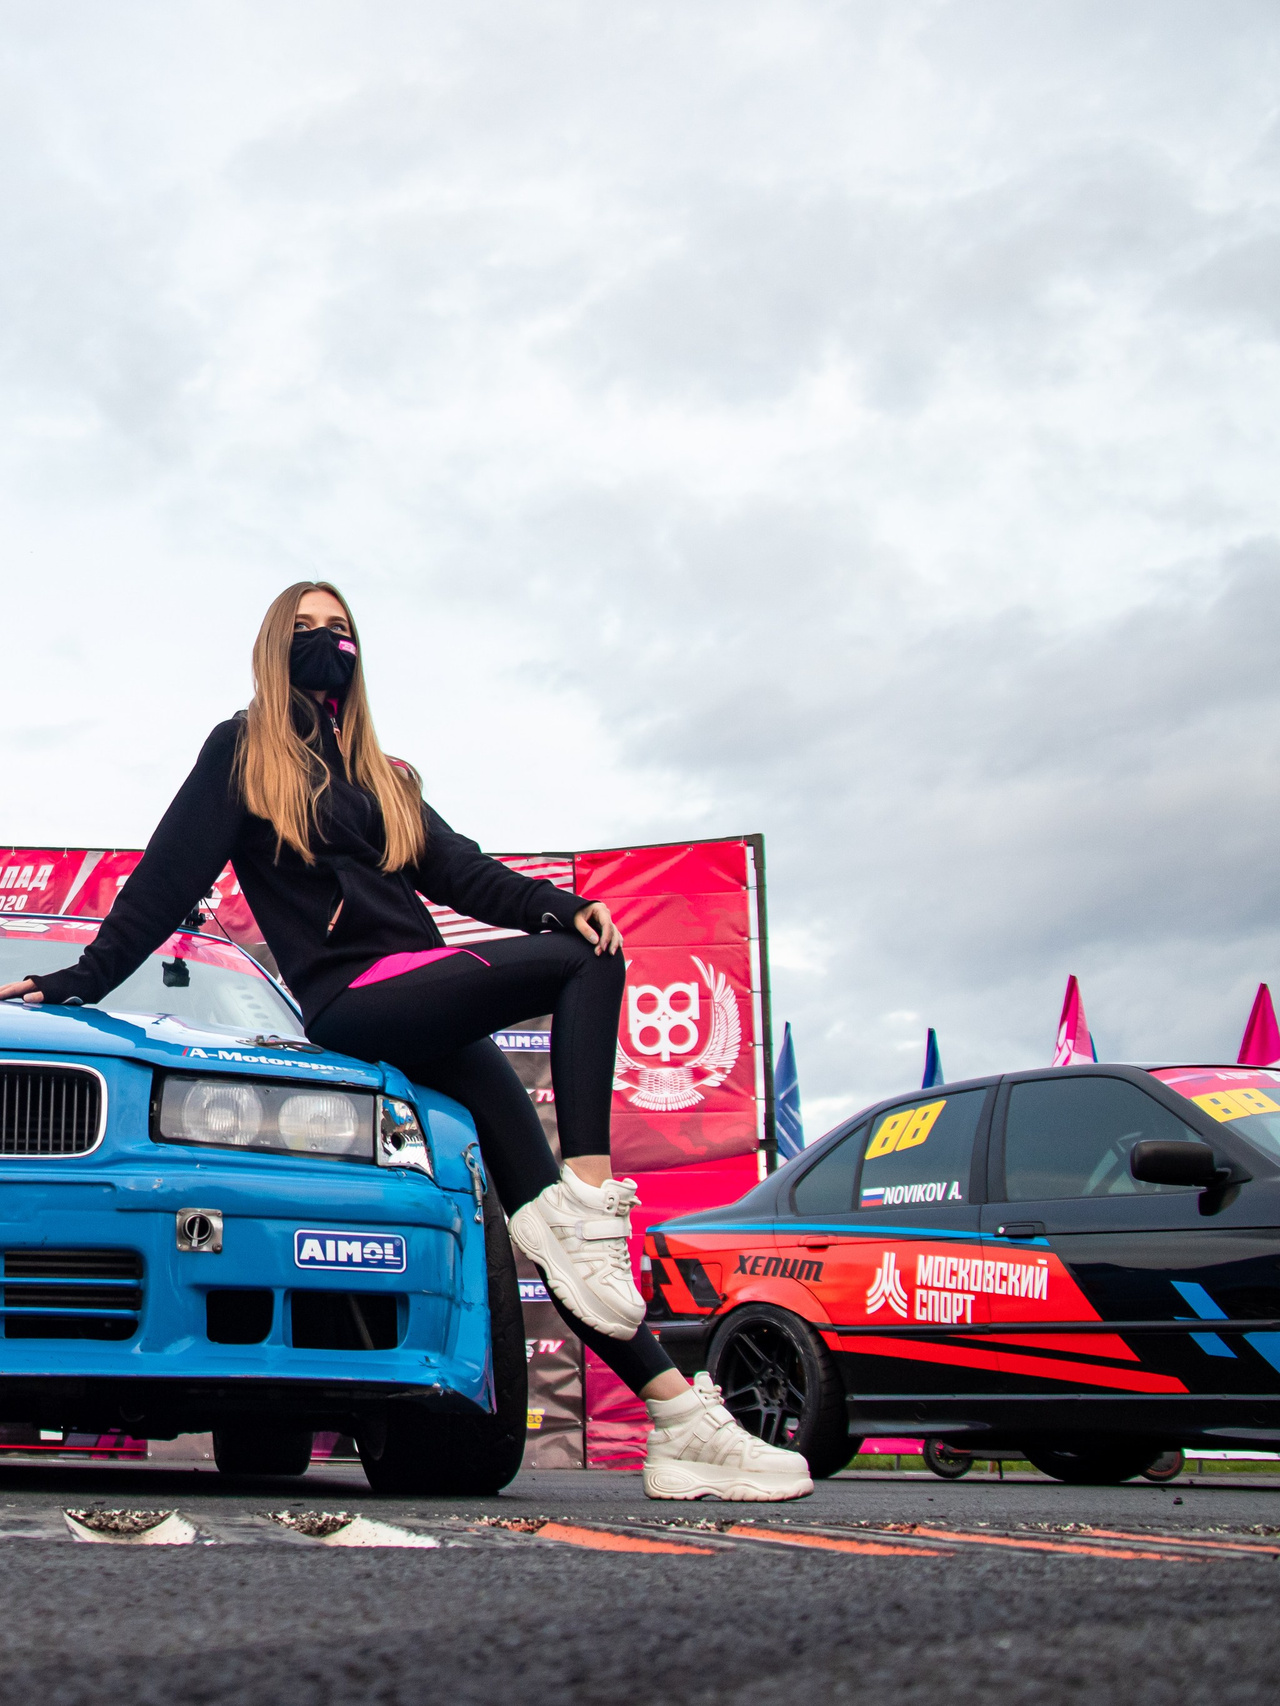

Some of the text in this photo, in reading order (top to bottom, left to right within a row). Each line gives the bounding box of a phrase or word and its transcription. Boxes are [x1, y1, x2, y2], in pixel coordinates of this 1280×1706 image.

[62, 922, 100, 932] ЗА
[1189, 1088, 1280, 1123] 88
[865, 1100, 947, 1160] 88
[883, 1182, 963, 1205] NOVIKOV A.
[299, 1239, 402, 1264] AIMOL
[733, 1254, 824, 1283] XENUM
[916, 1254, 1049, 1301] МОСКОВСКИЙ
[915, 1288, 975, 1324] СПОРТ
[539, 1341, 565, 1353] TV
